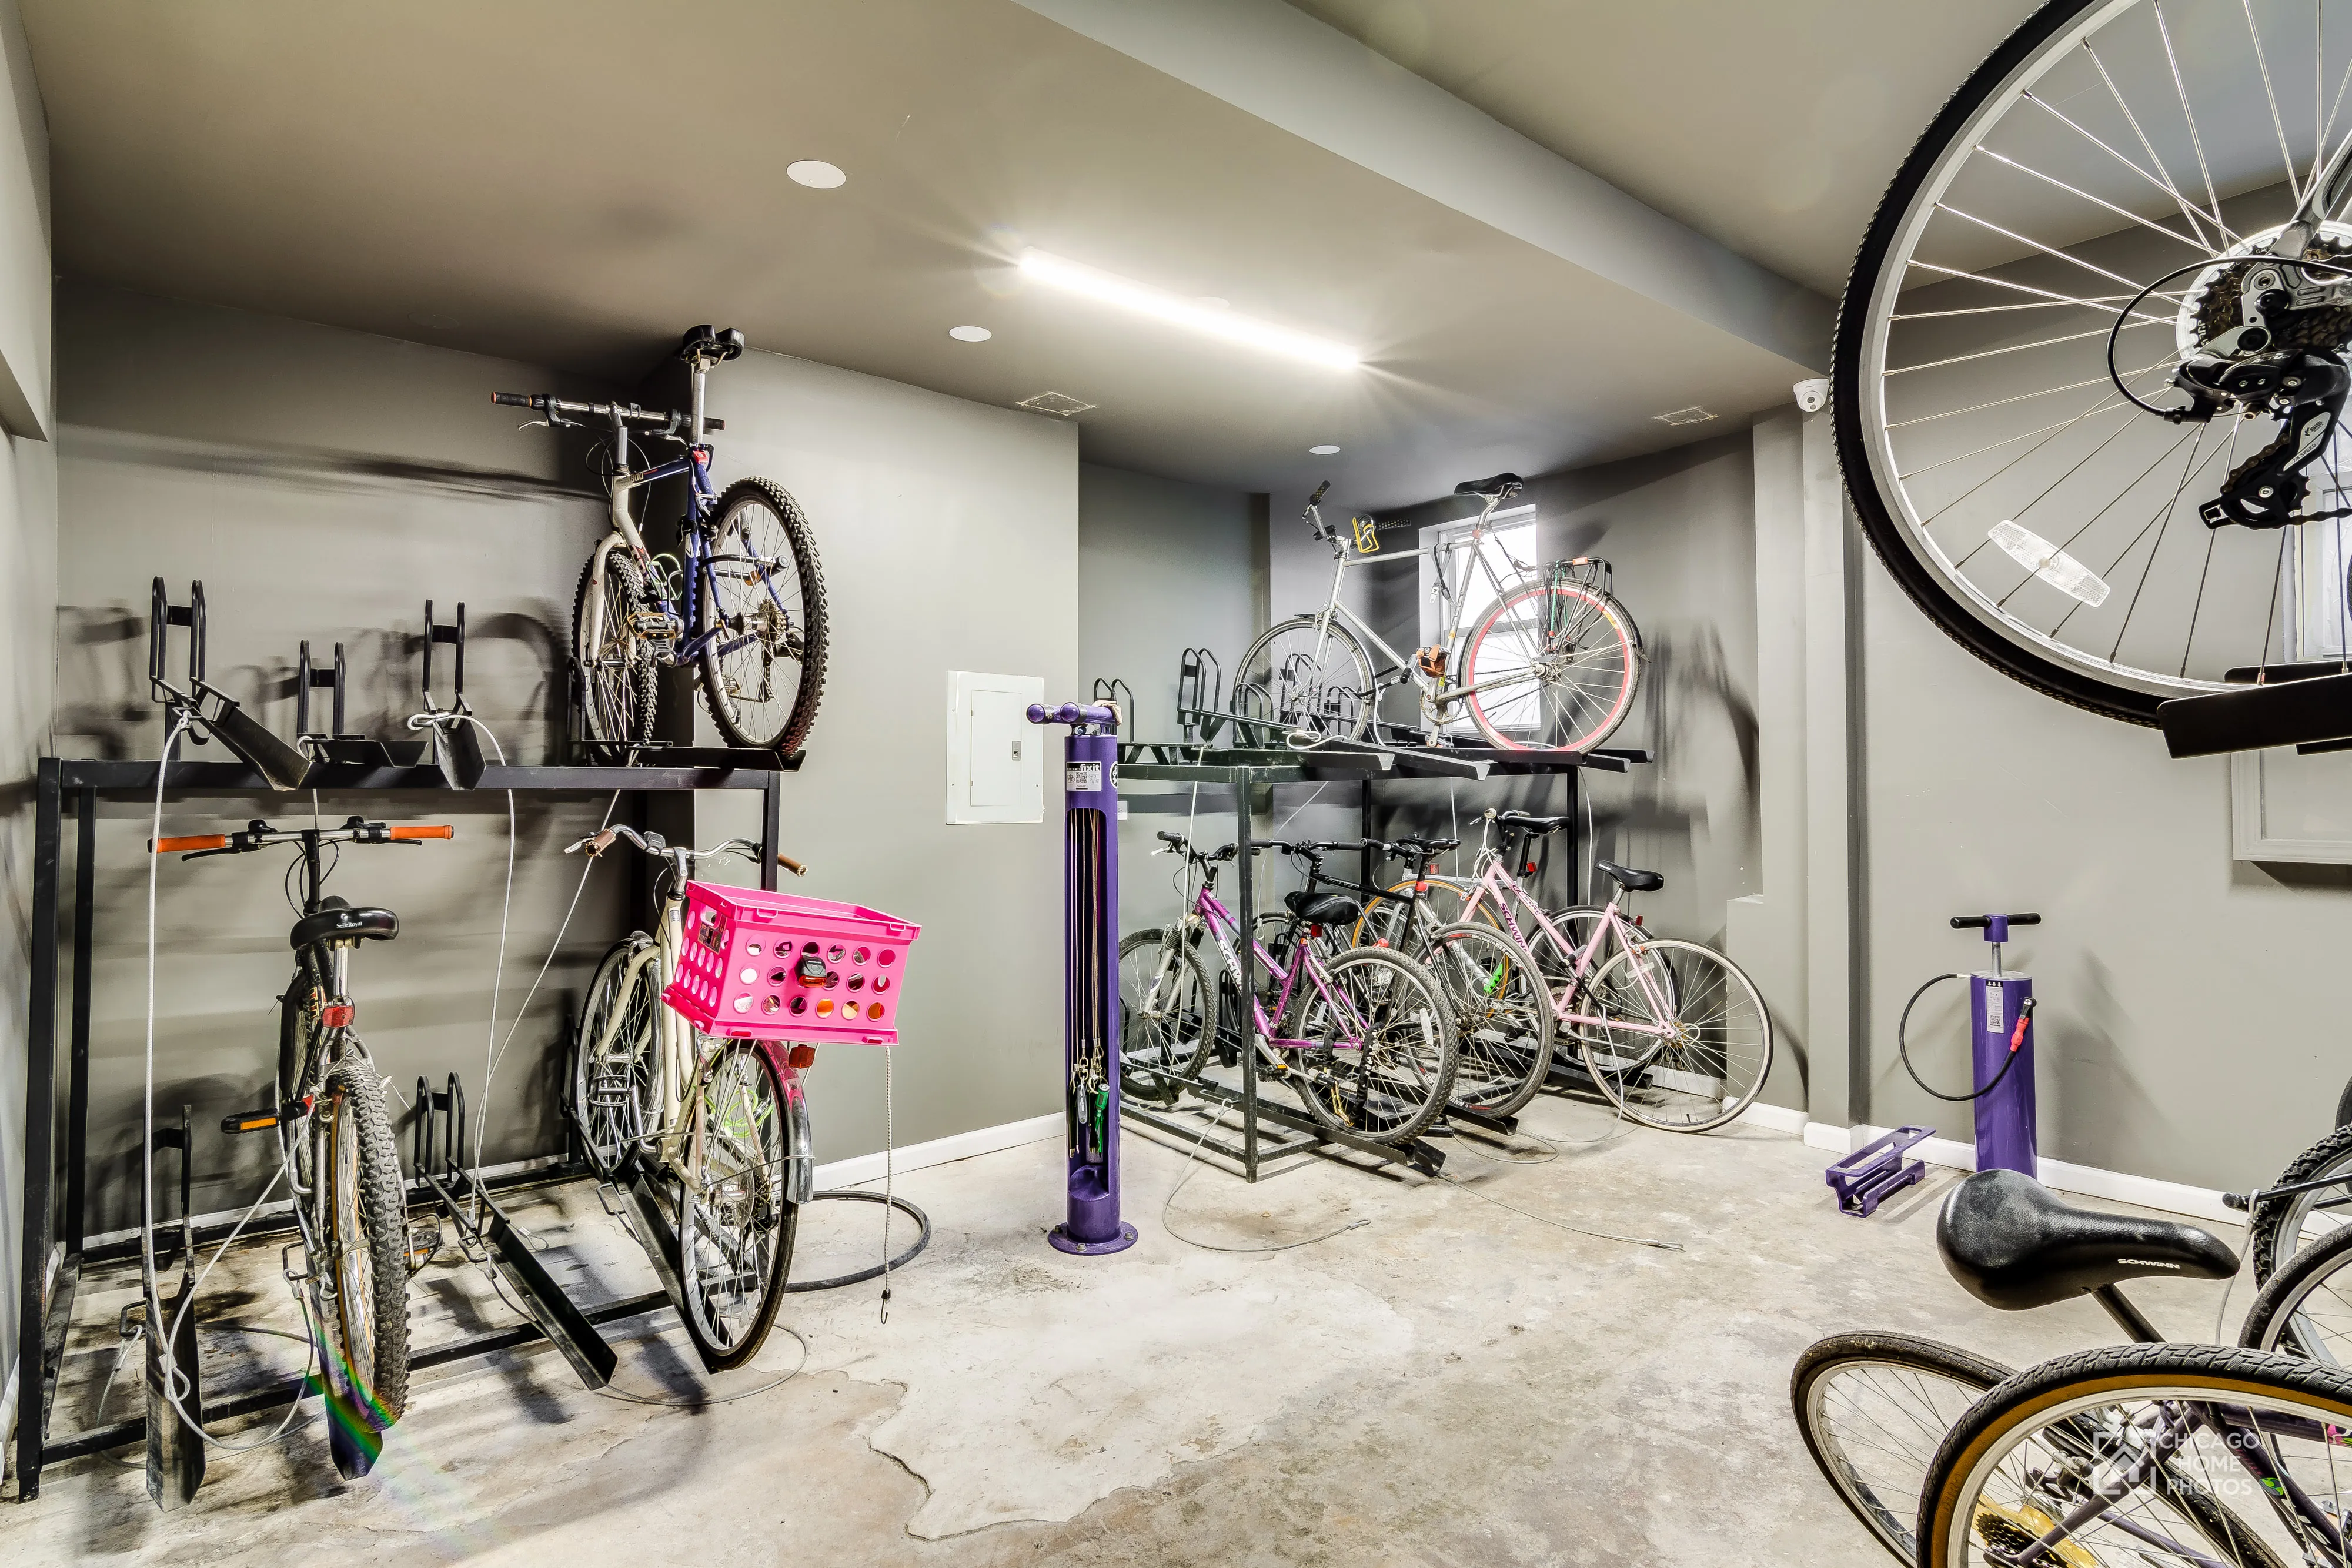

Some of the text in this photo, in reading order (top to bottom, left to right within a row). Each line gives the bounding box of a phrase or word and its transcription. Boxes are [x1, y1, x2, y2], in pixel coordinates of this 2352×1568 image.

[2300, 443, 2316, 457] SPEED
[1217, 938, 1242, 991] SCHW
[2117, 1258, 2180, 1269] SCHWINN
